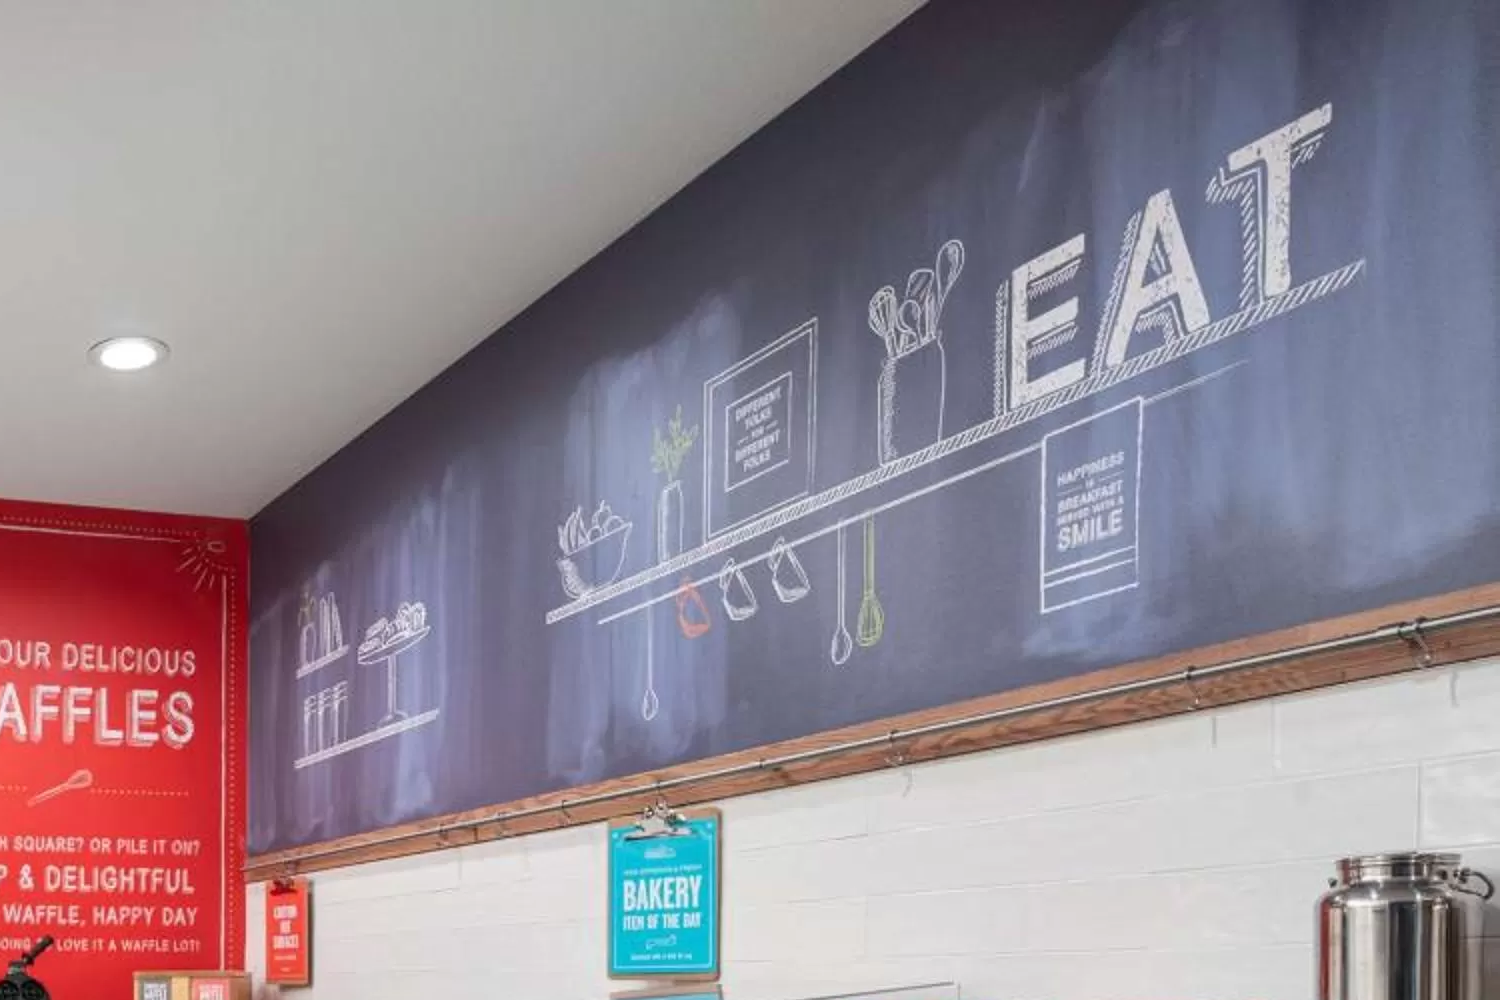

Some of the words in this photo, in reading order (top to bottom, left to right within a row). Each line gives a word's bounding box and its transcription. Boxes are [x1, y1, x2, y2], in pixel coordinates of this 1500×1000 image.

[994, 101, 1333, 416] EAT
[1057, 451, 1125, 488] HAPPINESS
[1058, 479, 1124, 513] BREAKFAST
[1057, 507, 1124, 552] SMILE
[61, 643, 196, 678] DELICIOUS
[13, 835, 85, 854] SQUARE?
[89, 838, 112, 853] OR
[116, 839, 147, 854] PILE
[153, 840, 166, 855] IT
[171, 840, 201, 856] ON?
[18, 863, 35, 890] &
[45, 864, 196, 895] DELIGHTFUL
[623, 875, 703, 912] BAKERY
[3, 903, 86, 926] WAFFLE,
[93, 906, 154, 926] HAPPY
[162, 907, 198, 927] DAY
[622, 914, 646, 931] ITEM
[647, 914, 659, 929] OF
[663, 913, 681, 929] THE
[683, 911, 702, 928] DAY
[56, 940, 89, 952] LOVE
[93, 939, 104, 952] IT
[107, 940, 118, 952] A
[120, 940, 169, 953] WAFFLE
[173, 940, 200, 953] LOT!
